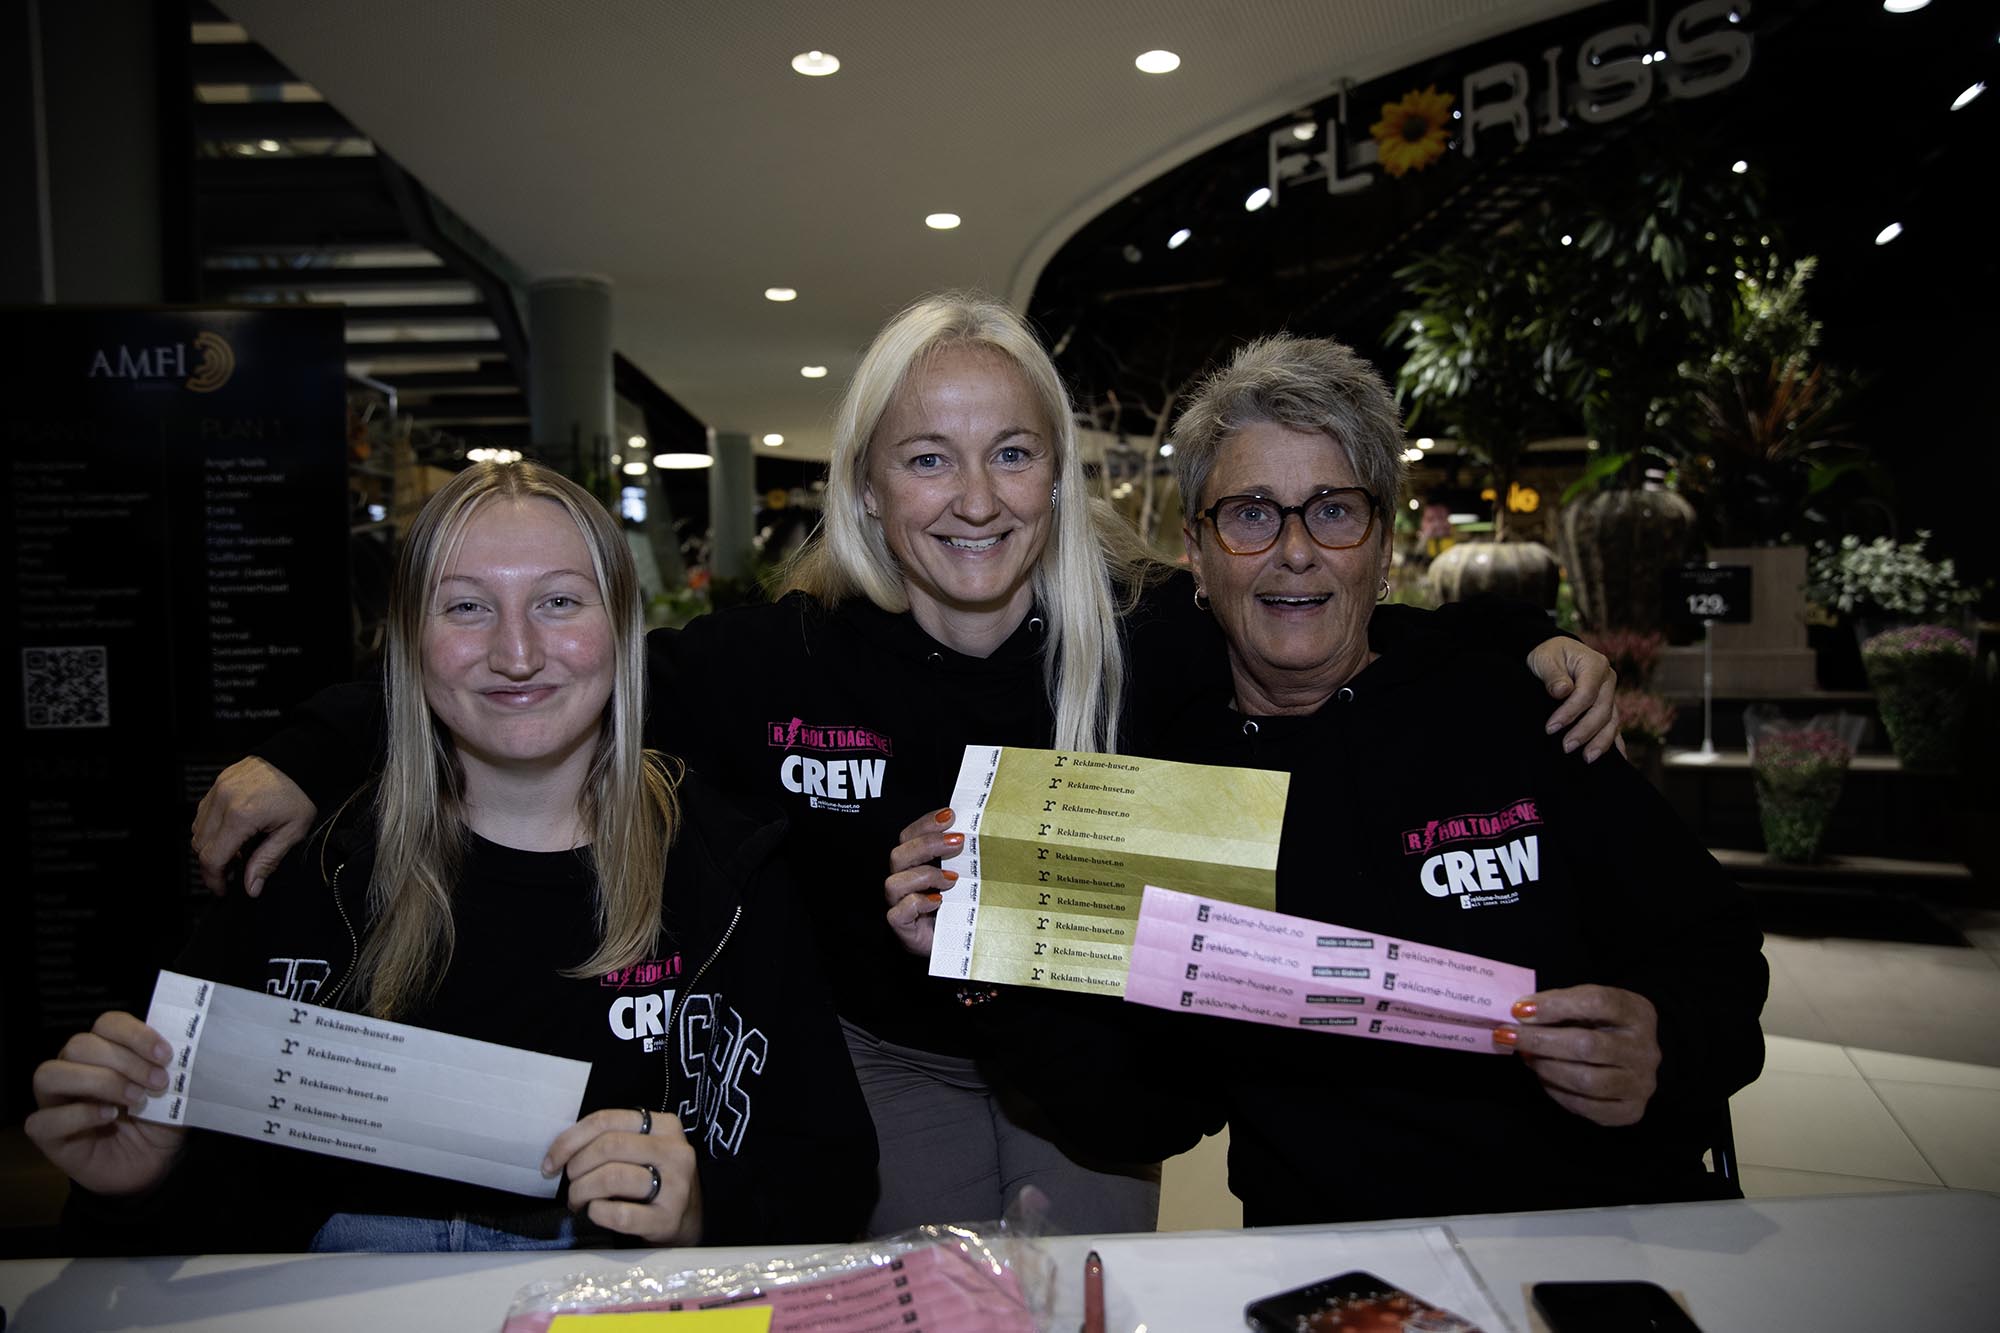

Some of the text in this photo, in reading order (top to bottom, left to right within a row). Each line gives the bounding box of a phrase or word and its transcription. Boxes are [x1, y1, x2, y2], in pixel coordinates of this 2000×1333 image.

[87, 343, 187, 380] AMFI
[780, 754, 887, 800] CREW
[1073, 759, 1140, 772] Reklame-huset.no
[1067, 781, 1135, 795] Reklame-huset.no
[1062, 804, 1130, 818] Reklame-huset.no
[1057, 828, 1126, 843] Reklame-huset.no
[1056, 853, 1124, 867] Reklame-huset.no
[1419, 834, 1540, 898] CREW
[1056, 875, 1125, 889] Reklame-huset.no
[1057, 897, 1126, 911] Reklame-huset.no
[1056, 922, 1124, 936] Reklame-huset.no
[1212, 912, 1304, 938] reklame-huset.no
[1053, 947, 1122, 961] Reklame-huset.no
[1206, 941, 1299, 968] reklame-huset.no
[1401, 951, 1494, 977] reklame-huset.no
[1051, 973, 1120, 987] Reklame-huset.no
[1398, 981, 1492, 1006] reklame-huset.no
[315, 1016, 404, 1043] Reklame-huset.no
[1383, 1024, 1474, 1043] reklame-huset.no
[307, 1047, 396, 1072] Reklame-huset.no
[299, 1077, 388, 1102] Reklame-huset.no
[294, 1103, 382, 1128] Reklame-huset.no
[289, 1128, 377, 1153] Reklame-huset.no
